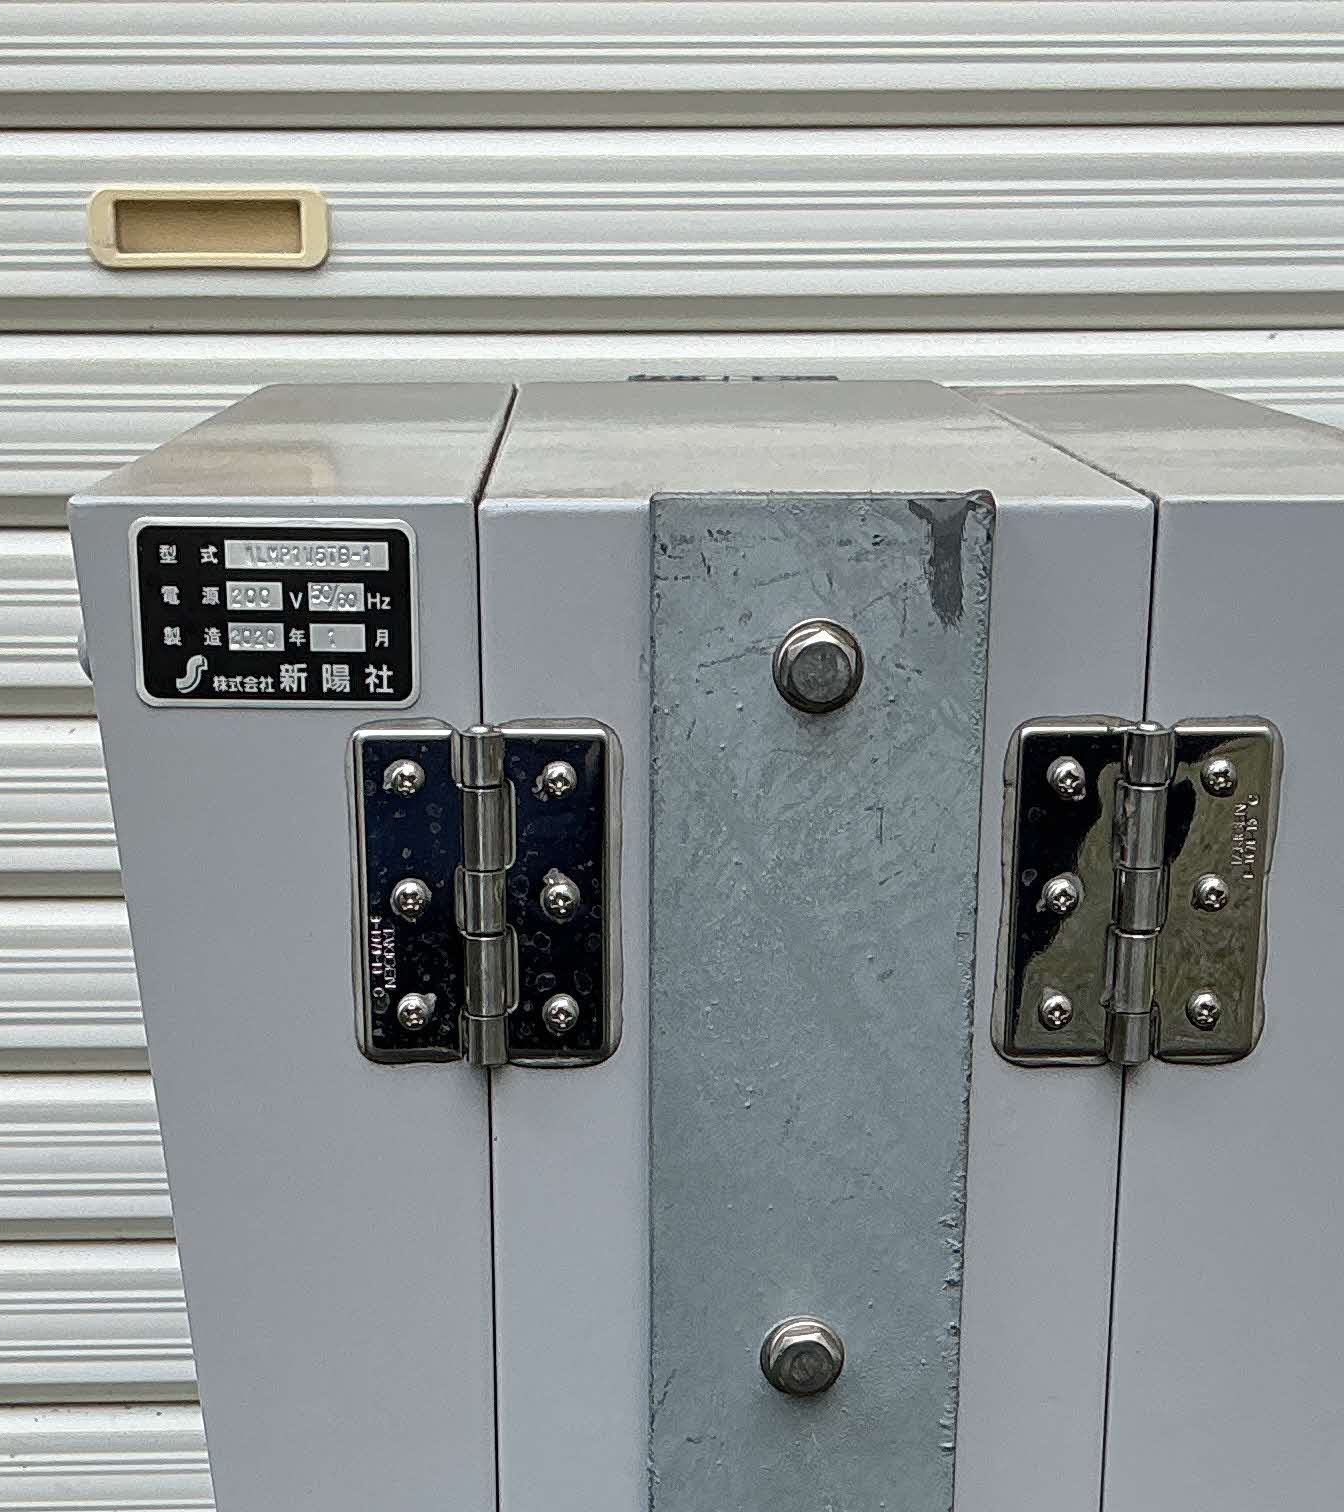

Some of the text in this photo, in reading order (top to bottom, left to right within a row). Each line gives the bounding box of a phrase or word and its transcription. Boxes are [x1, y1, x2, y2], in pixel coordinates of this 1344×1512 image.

[159, 544, 219, 564] 型式
[160, 585, 220, 606] 電源
[289, 591, 303, 609] V
[367, 592, 391, 610] Hz
[163, 626, 222, 647] 製造
[288, 628, 306, 647] 年
[374, 628, 390, 648] 月
[212, 675, 275, 693] 株式会社
[279, 663, 394, 694] 新陽社
